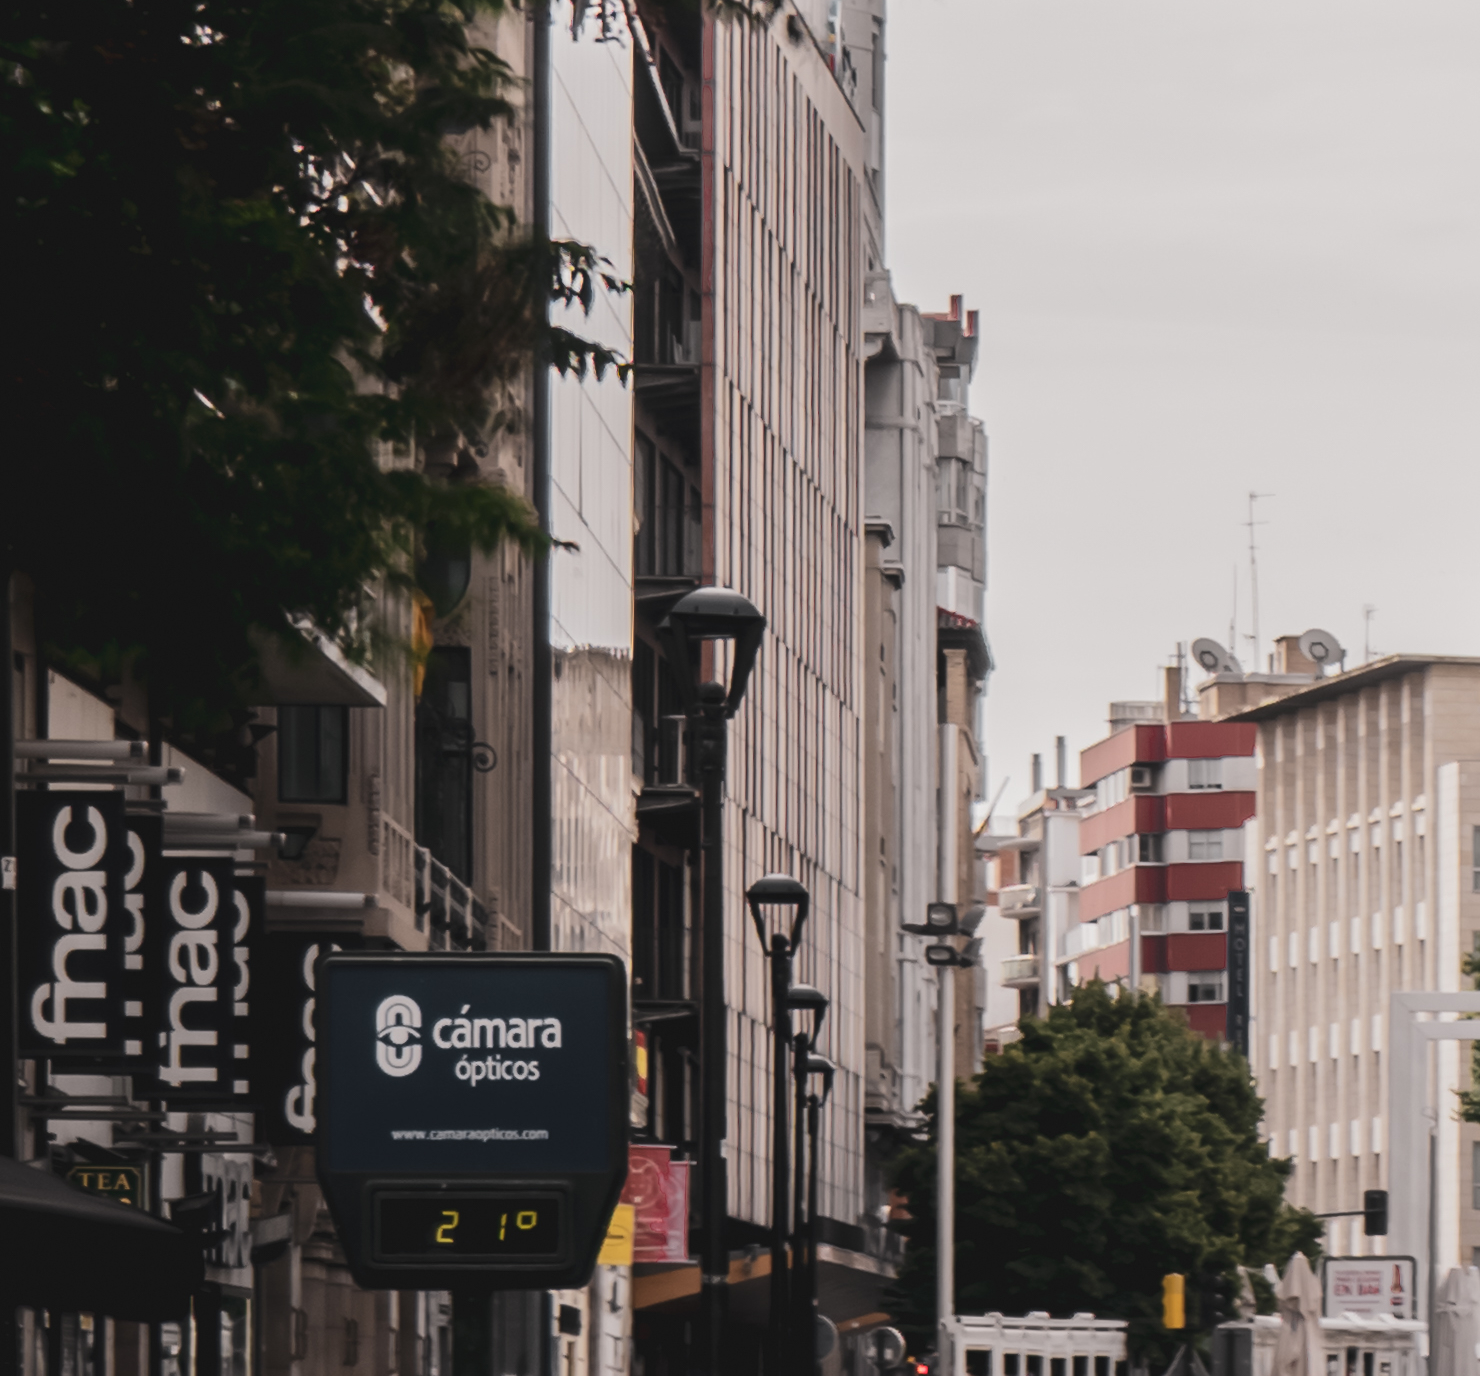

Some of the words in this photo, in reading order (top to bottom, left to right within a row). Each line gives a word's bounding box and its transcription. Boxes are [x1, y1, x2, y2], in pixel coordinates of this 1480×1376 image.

[31, 805, 107, 1044] fnac
[432, 1004, 562, 1049] cámara
[455, 1054, 540, 1087] ópticos
[391, 1128, 549, 1142] www.camaraopticos.com
[77, 1172, 131, 1190] TEA
